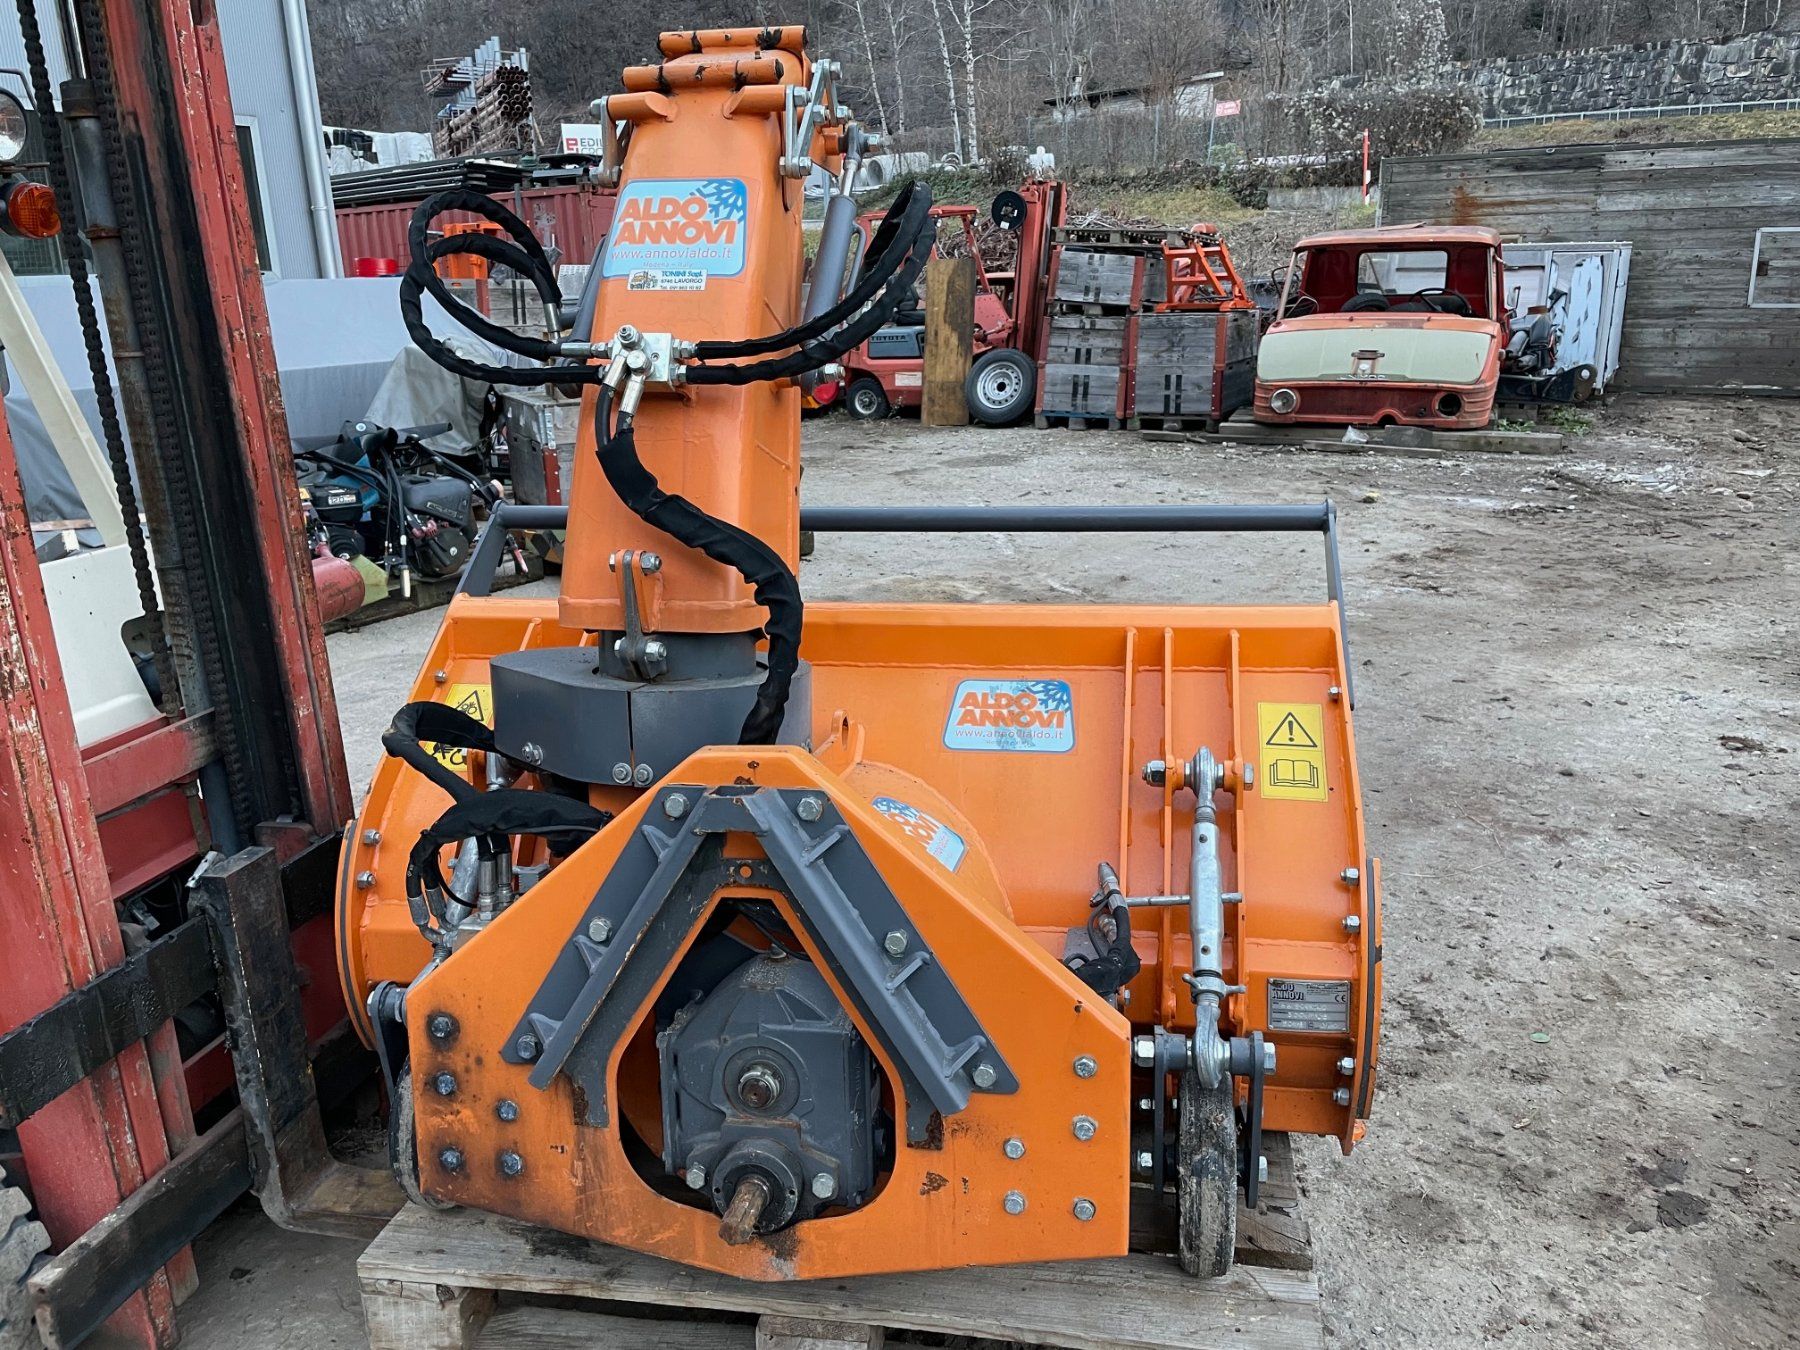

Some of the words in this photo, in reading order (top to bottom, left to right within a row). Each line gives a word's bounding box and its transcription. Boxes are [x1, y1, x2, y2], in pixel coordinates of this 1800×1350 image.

[619, 196, 707, 222] ALDO
[614, 221, 737, 247] ANNOVI
[611, 247, 732, 260] www.annovialdo.it
[958, 691, 1039, 712] ALDO
[955, 709, 1066, 730] ANNOVI
[1272, 990, 1305, 1001] ANNOVI
